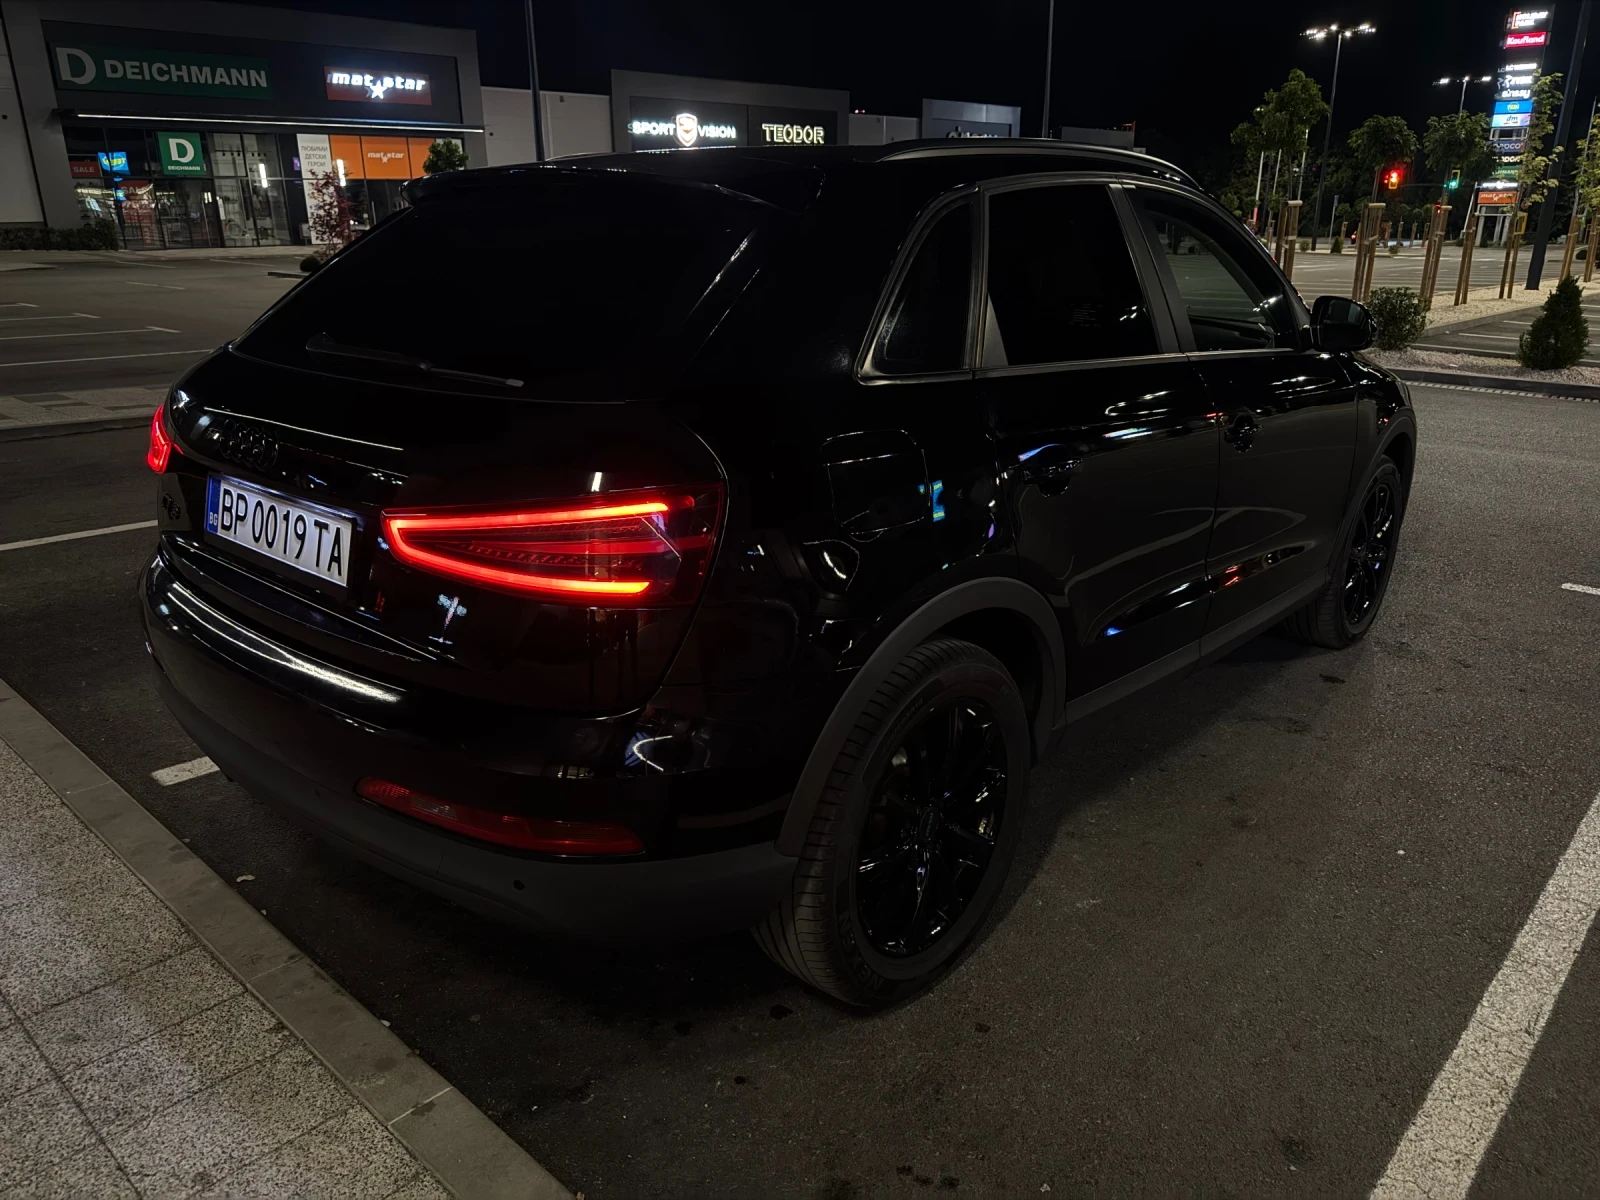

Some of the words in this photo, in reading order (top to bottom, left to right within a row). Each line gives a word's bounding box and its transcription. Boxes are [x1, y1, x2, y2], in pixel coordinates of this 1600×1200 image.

[1506, 35, 1545, 45] Kaufland
[56, 47, 97, 85] D
[103, 59, 268, 88] DEICHMANN
[331, 72, 374, 87] mat
[631, 121, 675, 136] SPORT
[697, 125, 737, 138] VISION
[762, 123, 825, 144] TEODOR
[168, 138, 195, 163] D
[300, 145, 328, 153] ЛЮБИМИ
[208, 511, 219, 527] BG
[838, 910, 885, 991] NEXEN
